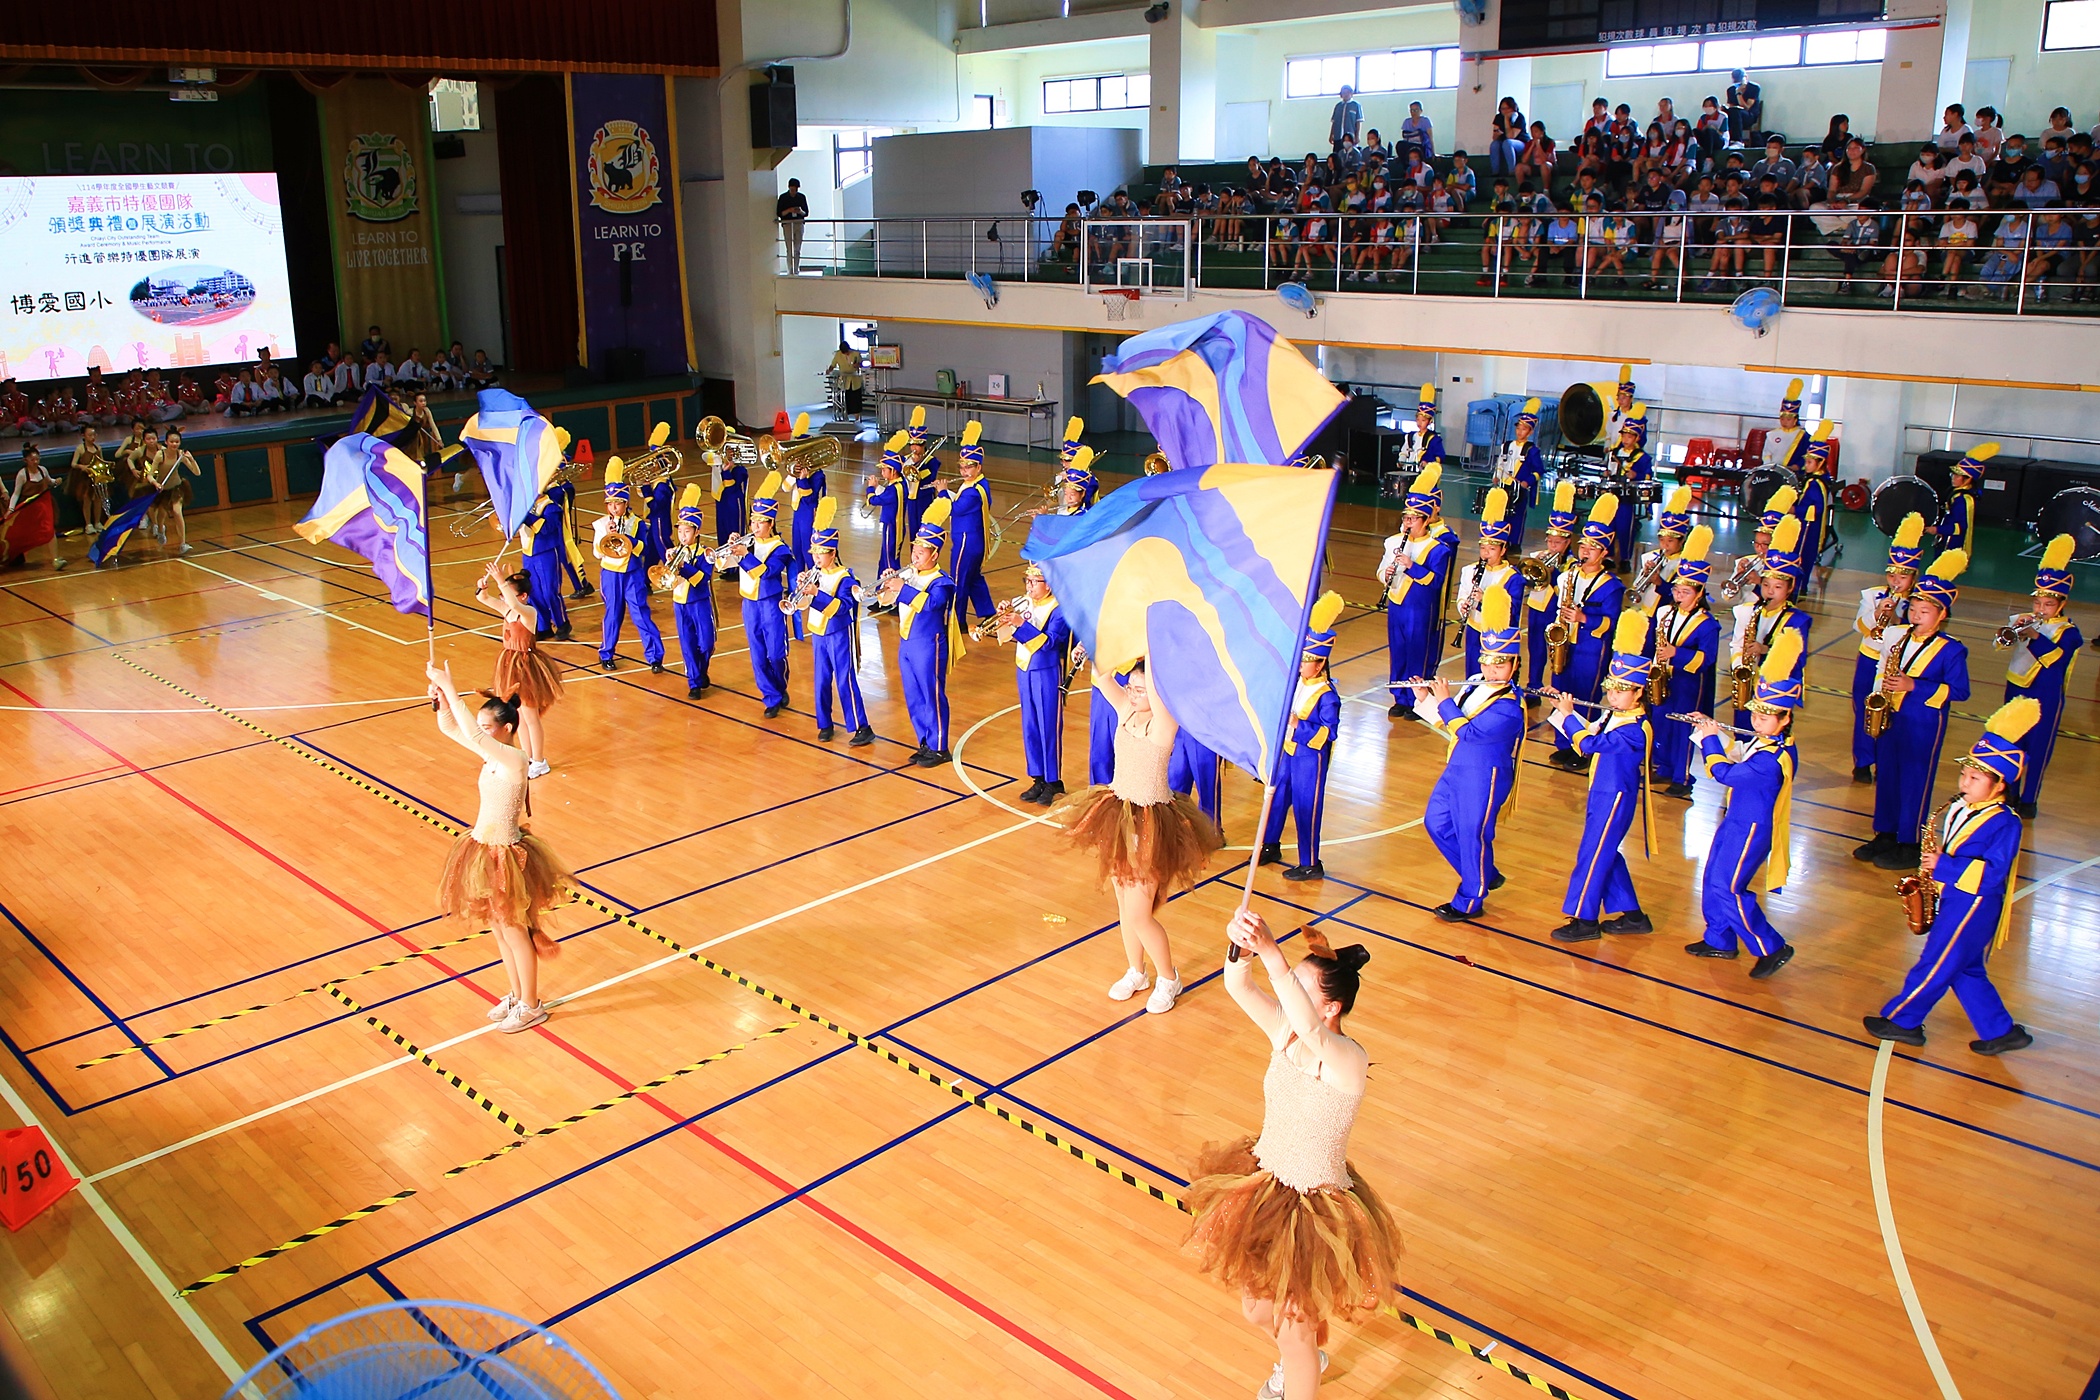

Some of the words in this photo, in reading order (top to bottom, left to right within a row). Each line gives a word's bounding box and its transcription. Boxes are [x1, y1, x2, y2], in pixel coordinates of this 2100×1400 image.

[42, 142, 172, 174] LEARN
[184, 142, 235, 173] TO
[67, 194, 194, 214] 嘉義市特優團隊
[352, 231, 396, 245] LEARN
[400, 230, 418, 243] TO
[594, 224, 639, 240] LEARN
[642, 223, 662, 237] TO
[65, 249, 200, 265] 行進管樂特優團隊展演
[346, 249, 371, 268] LIVE
[372, 247, 428, 266] TOGETHER
[10, 290, 113, 315] 博愛國小
[16, 1149, 52, 1192] 50
